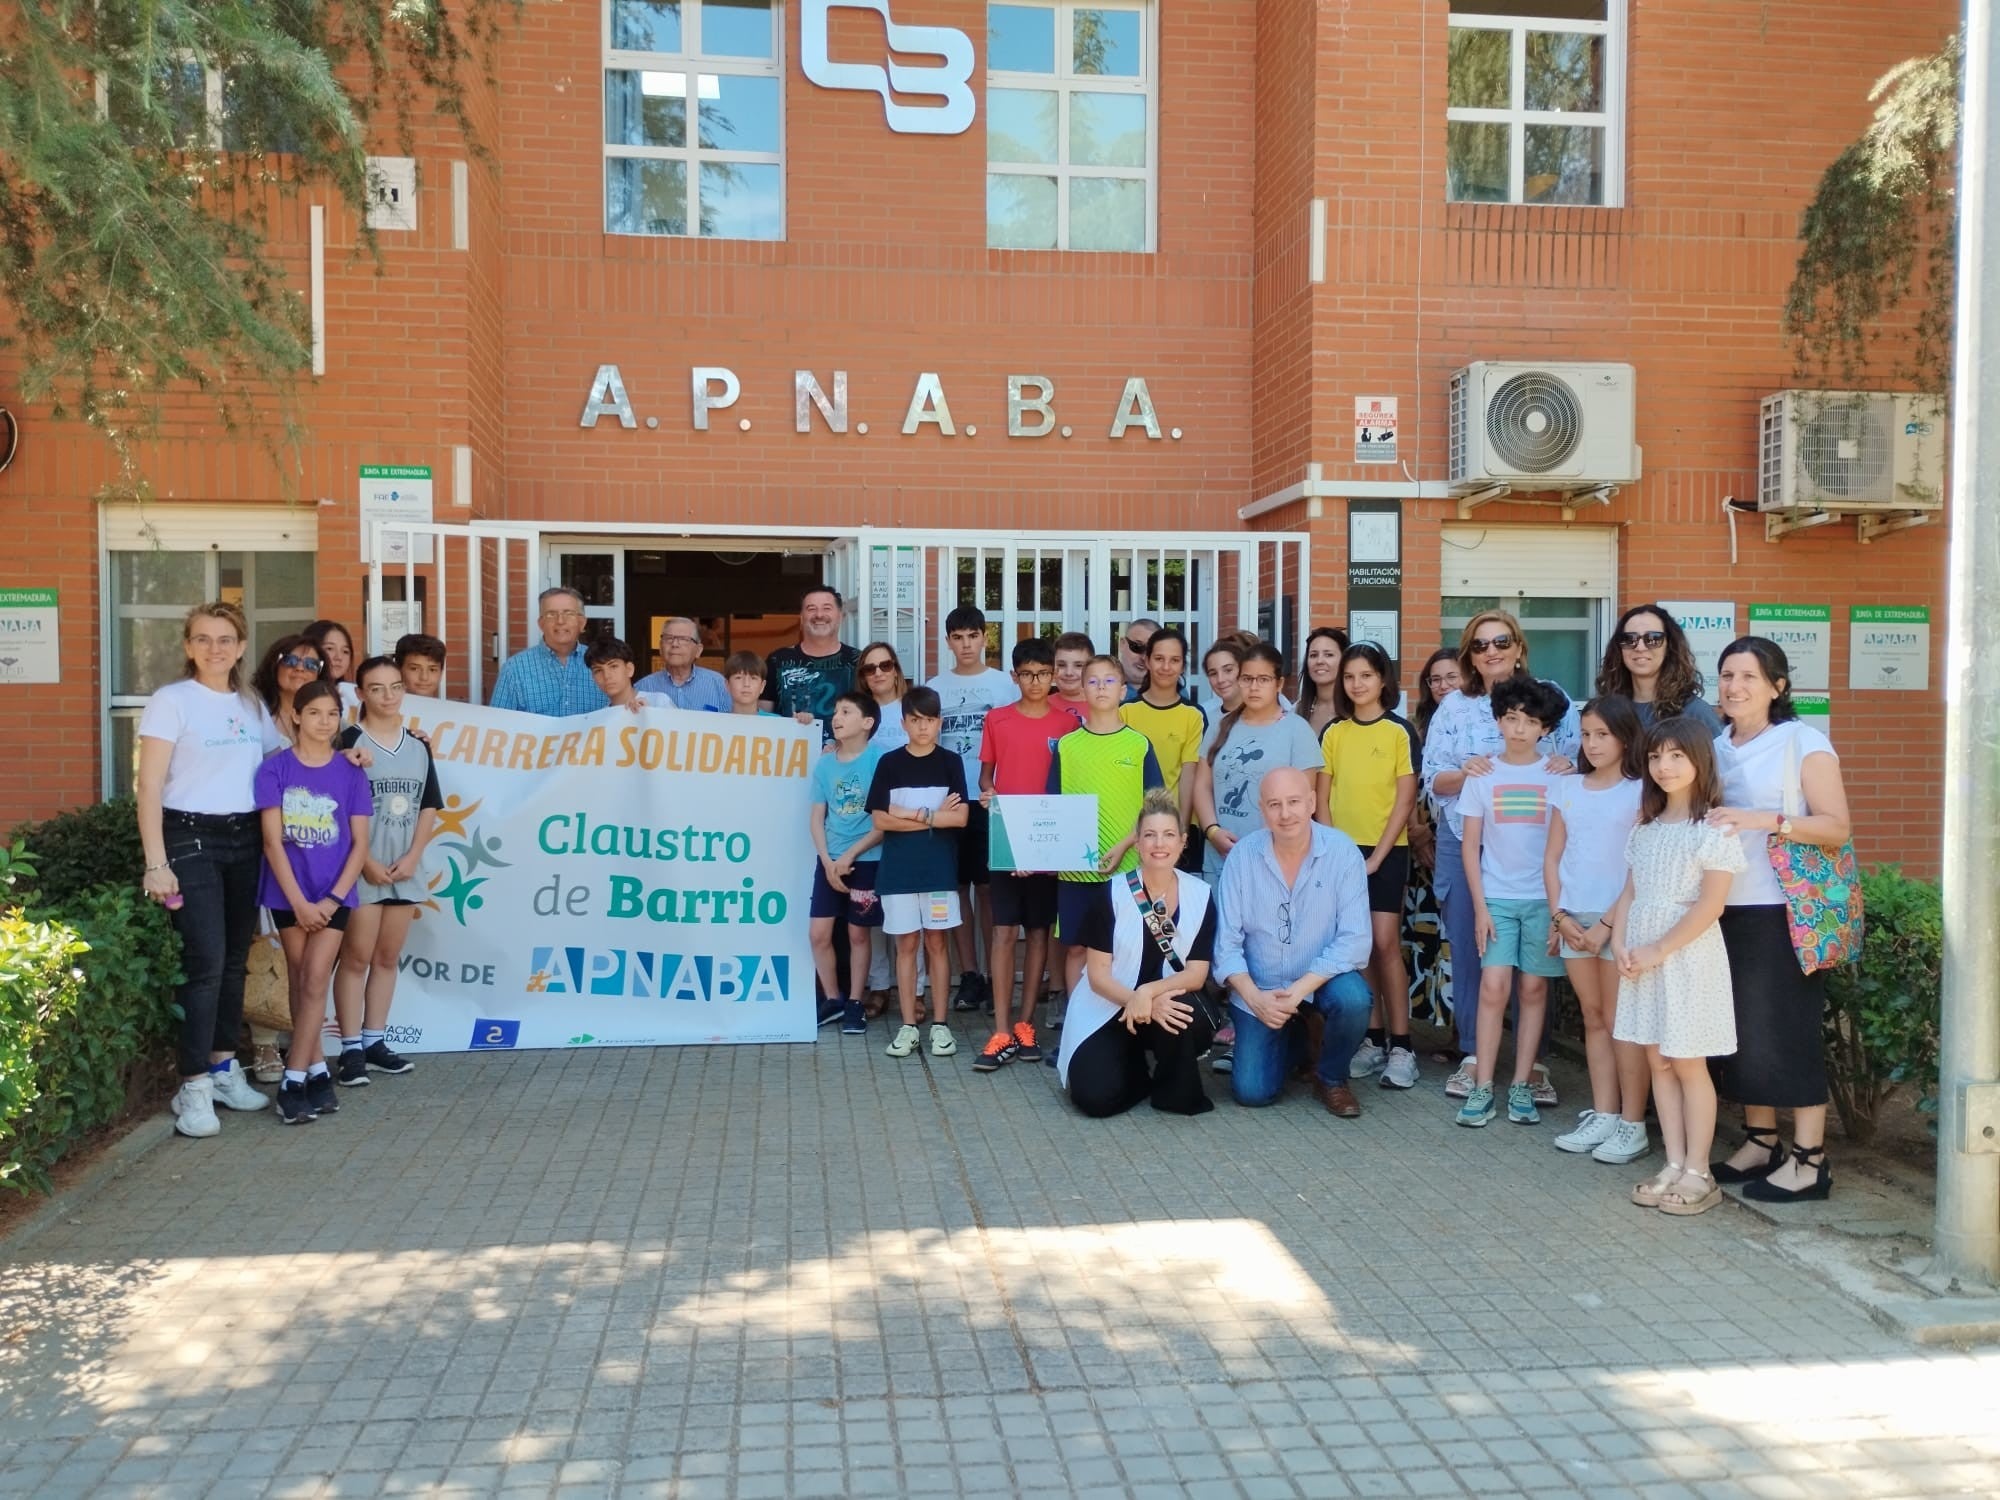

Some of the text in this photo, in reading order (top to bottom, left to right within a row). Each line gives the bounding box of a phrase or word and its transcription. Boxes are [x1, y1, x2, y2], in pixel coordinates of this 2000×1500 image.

[1349, 567, 1400, 576] HABILITACIÓN
[1353, 577, 1397, 585] FUNCIONAL
[1755, 608, 1827, 618] JUNTA DE EXTREMADURA
[1856, 610, 1926, 619] JUNTA DE EXTREMADURA
[1679, 616, 1731, 630] PNABA
[431, 720, 809, 779] CARRERA SOLIDARIA
[538, 812, 751, 864] Claustro
[532, 874, 788, 925] de Barrio
[398, 946, 790, 1002] VOR DE APNABA
